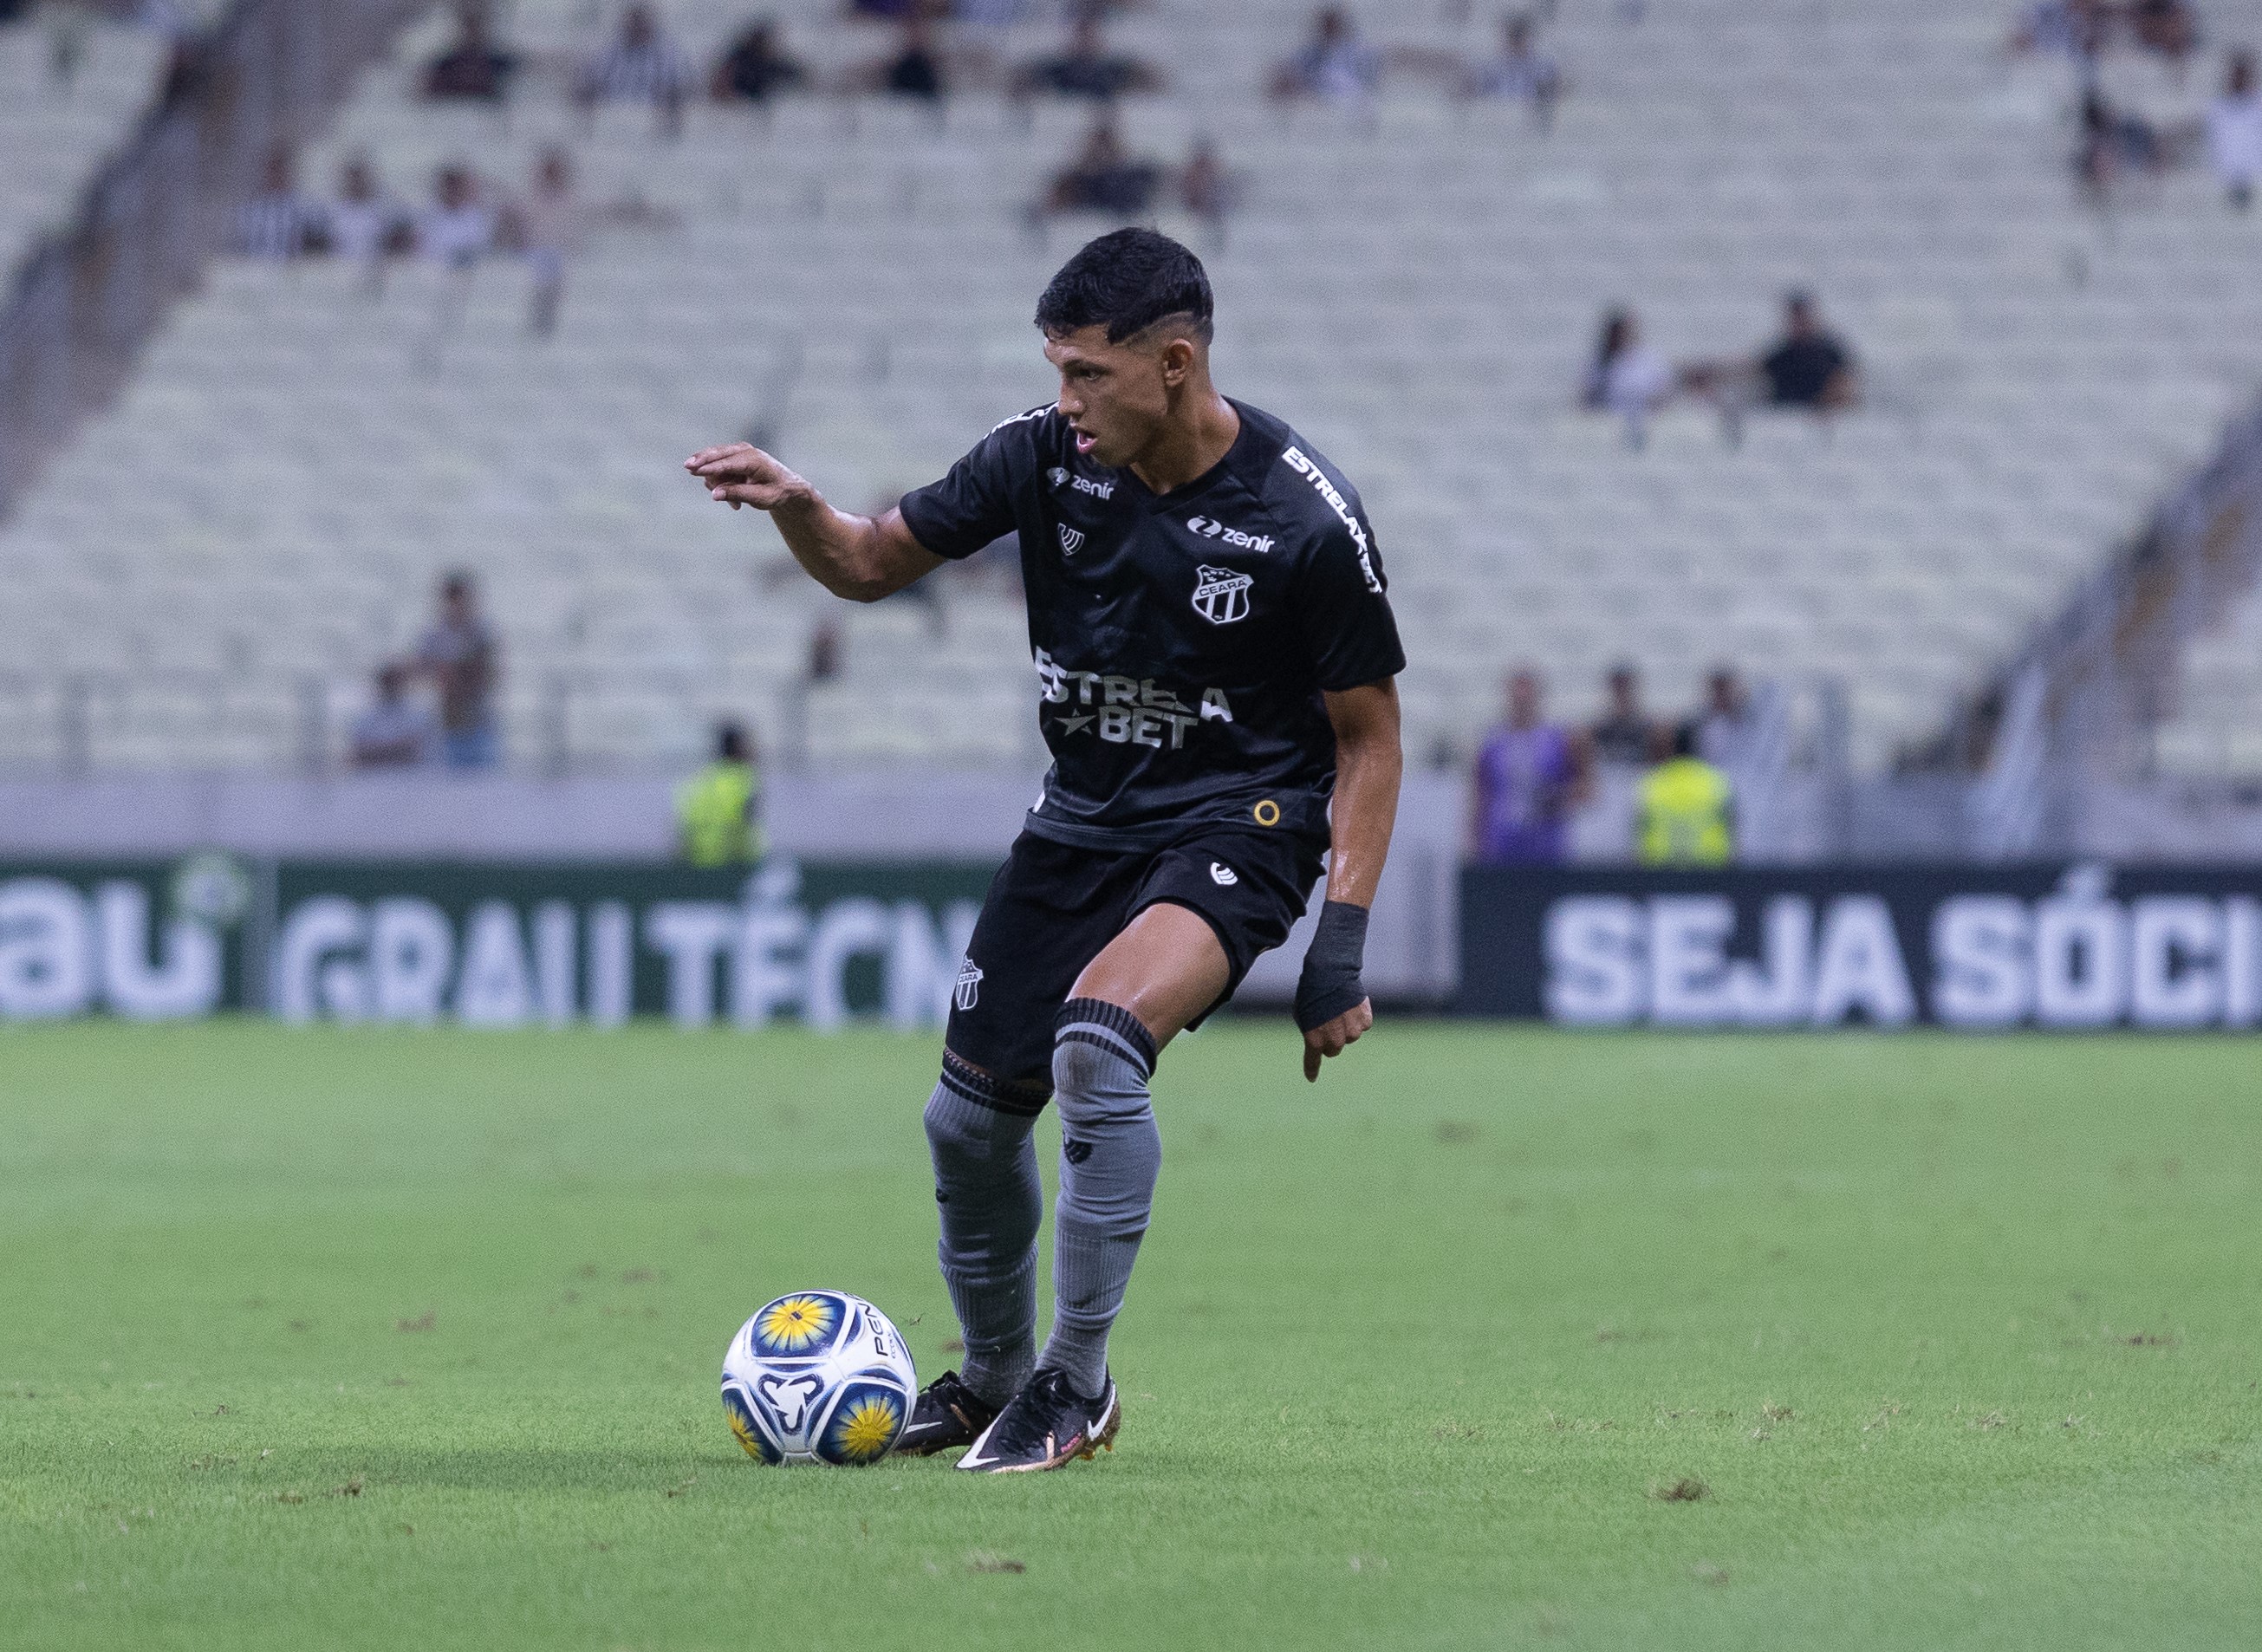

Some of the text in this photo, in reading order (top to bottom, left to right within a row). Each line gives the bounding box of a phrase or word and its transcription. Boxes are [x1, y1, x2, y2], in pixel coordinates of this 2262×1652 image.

[1071, 474, 1115, 501] zenir
[1282, 446, 1360, 537] ESTRELA
[1221, 527, 1276, 554] zenir
[1098, 704, 1199, 749] BET
[648, 858, 985, 1031] TÉCN
[1543, 893, 1915, 1026] SEJA
[844, 1291, 889, 1357] PEN
